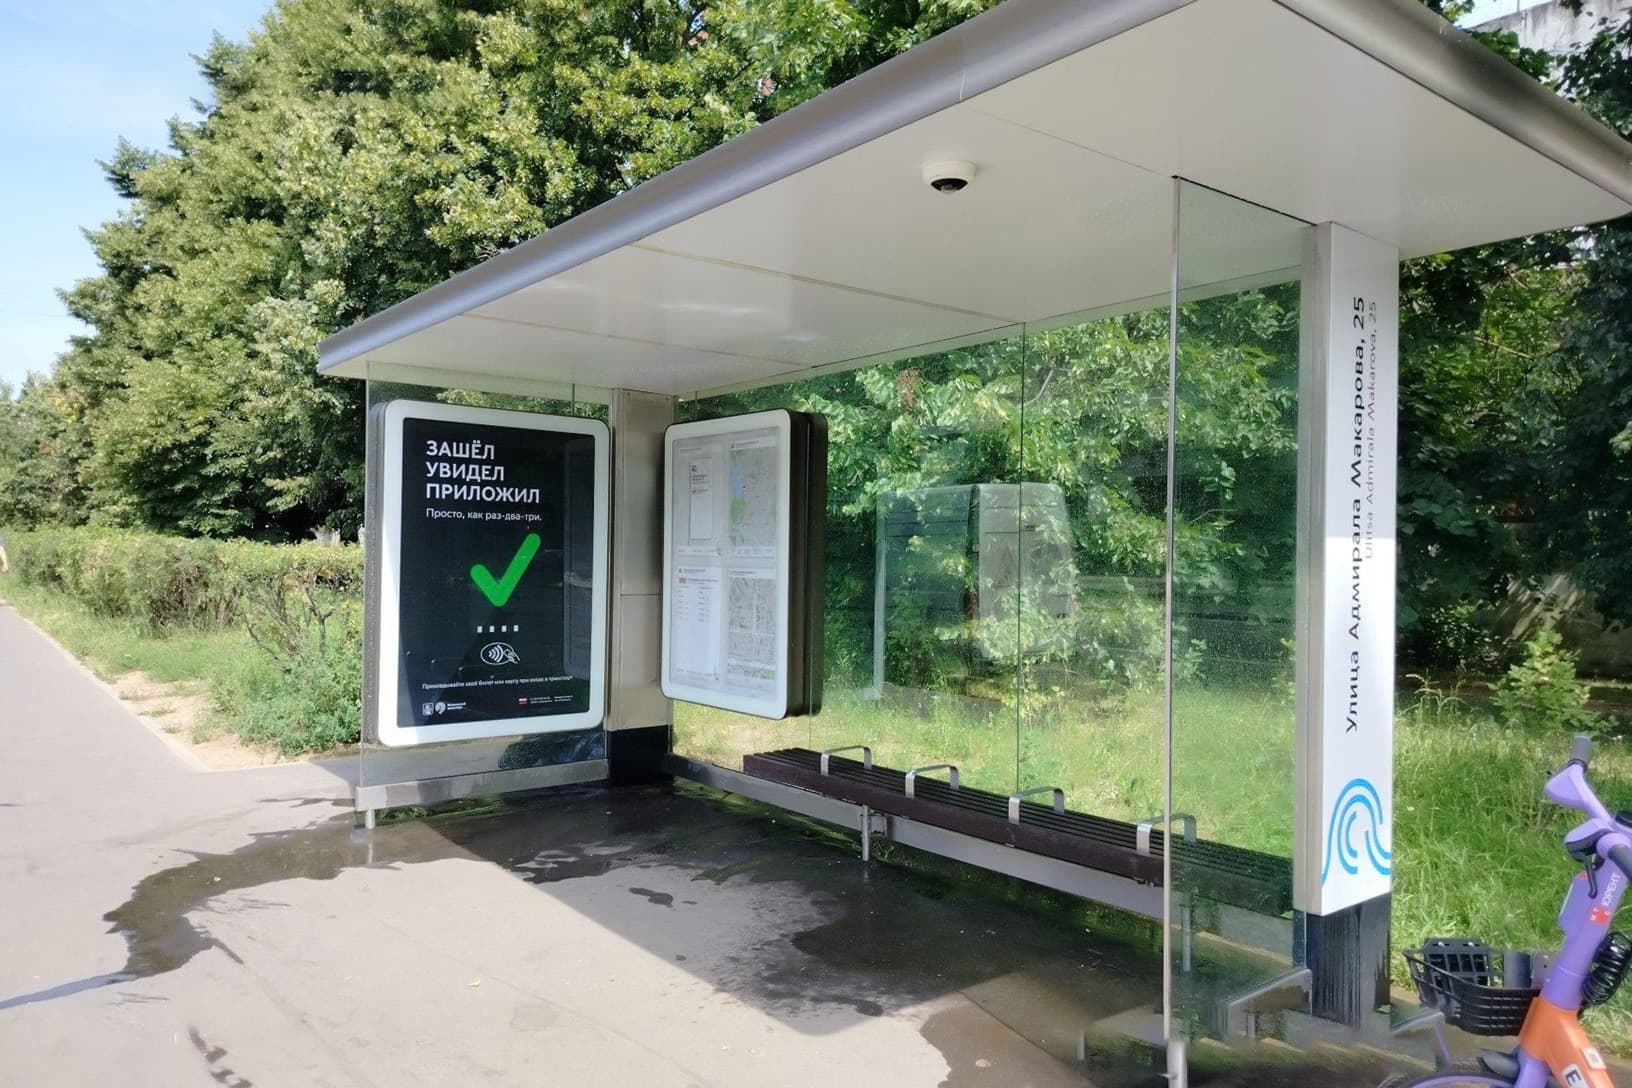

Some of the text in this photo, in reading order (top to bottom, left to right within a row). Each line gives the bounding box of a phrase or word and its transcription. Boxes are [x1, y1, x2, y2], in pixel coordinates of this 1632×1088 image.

[1364, 300, 1377, 560] Ulitsa Admirala Makarova, 25
[426, 439, 495, 460] ЗАШЁЛ
[425, 461, 505, 482] УВИДЕЛ
[426, 482, 540, 504] ПРИЛОЖИЛ
[426, 507, 543, 523] Просто, как раз-два-три.
[1346, 296, 1366, 733] Улица Адмирала Макарова, 25
